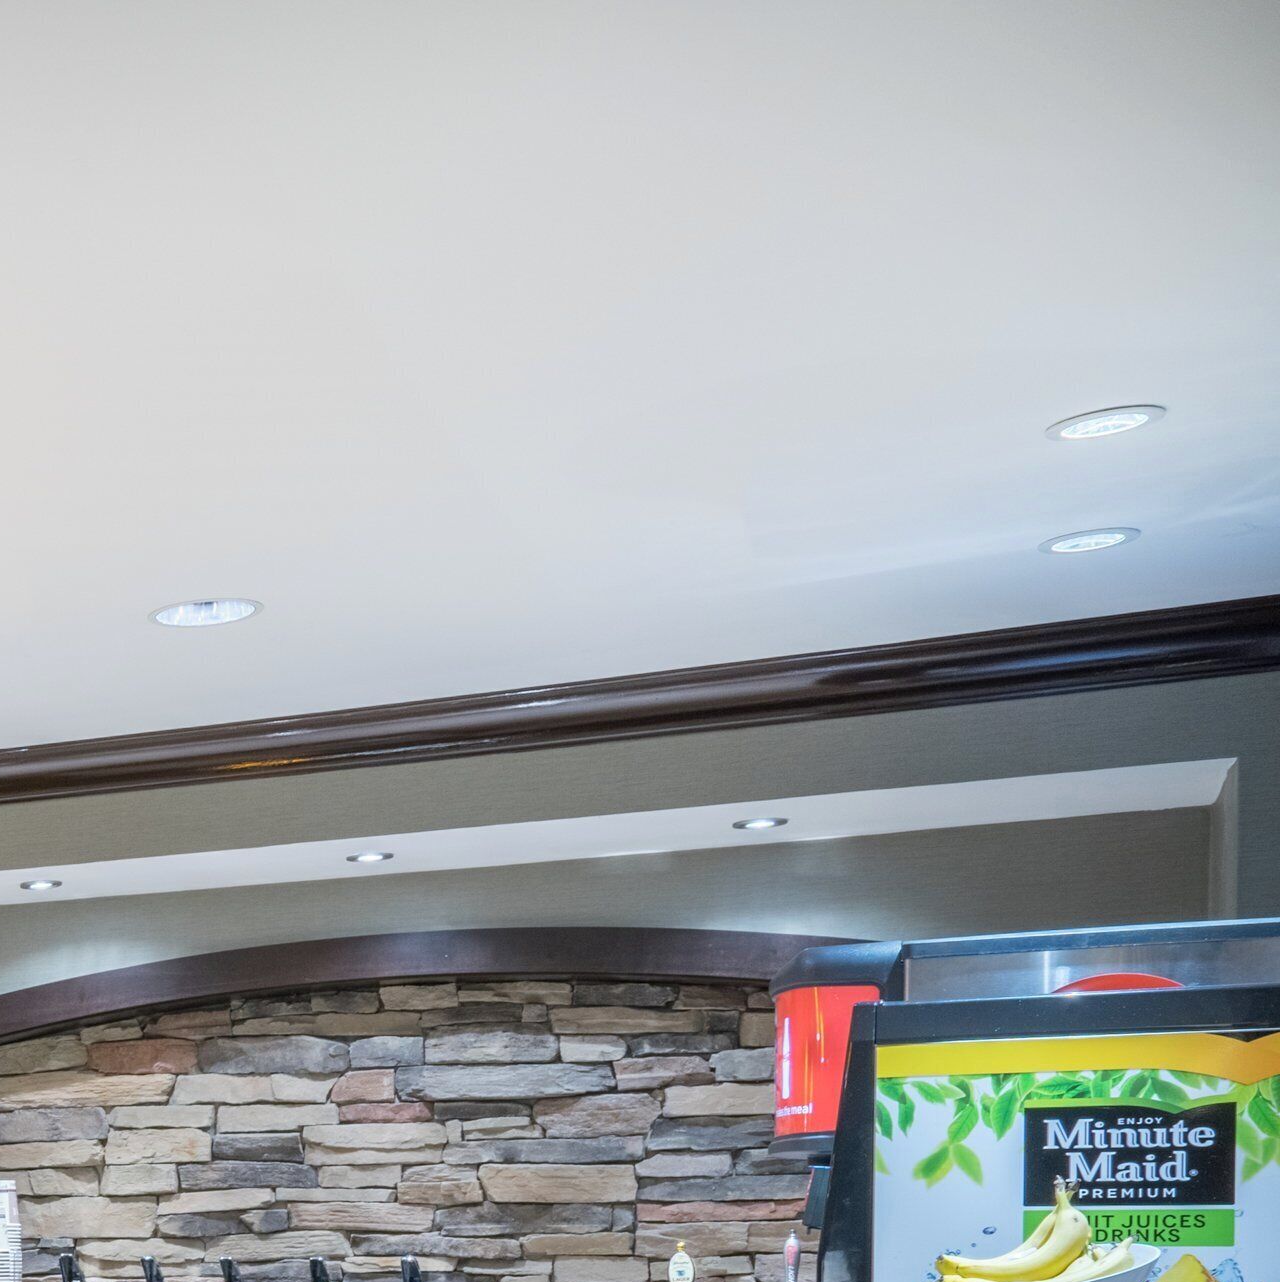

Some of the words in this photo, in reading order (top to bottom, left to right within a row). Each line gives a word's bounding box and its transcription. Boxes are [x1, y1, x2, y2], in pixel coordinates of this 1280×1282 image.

[1117, 1117, 1163, 1126] ENJOY
[1043, 1118, 1216, 1150] Minute
[1065, 1150, 1192, 1183] Maid
[1078, 1187, 1176, 1199] PREMIUM
[1121, 1214, 1206, 1228] JUICES
[1095, 1229, 1181, 1242] DRINKS
